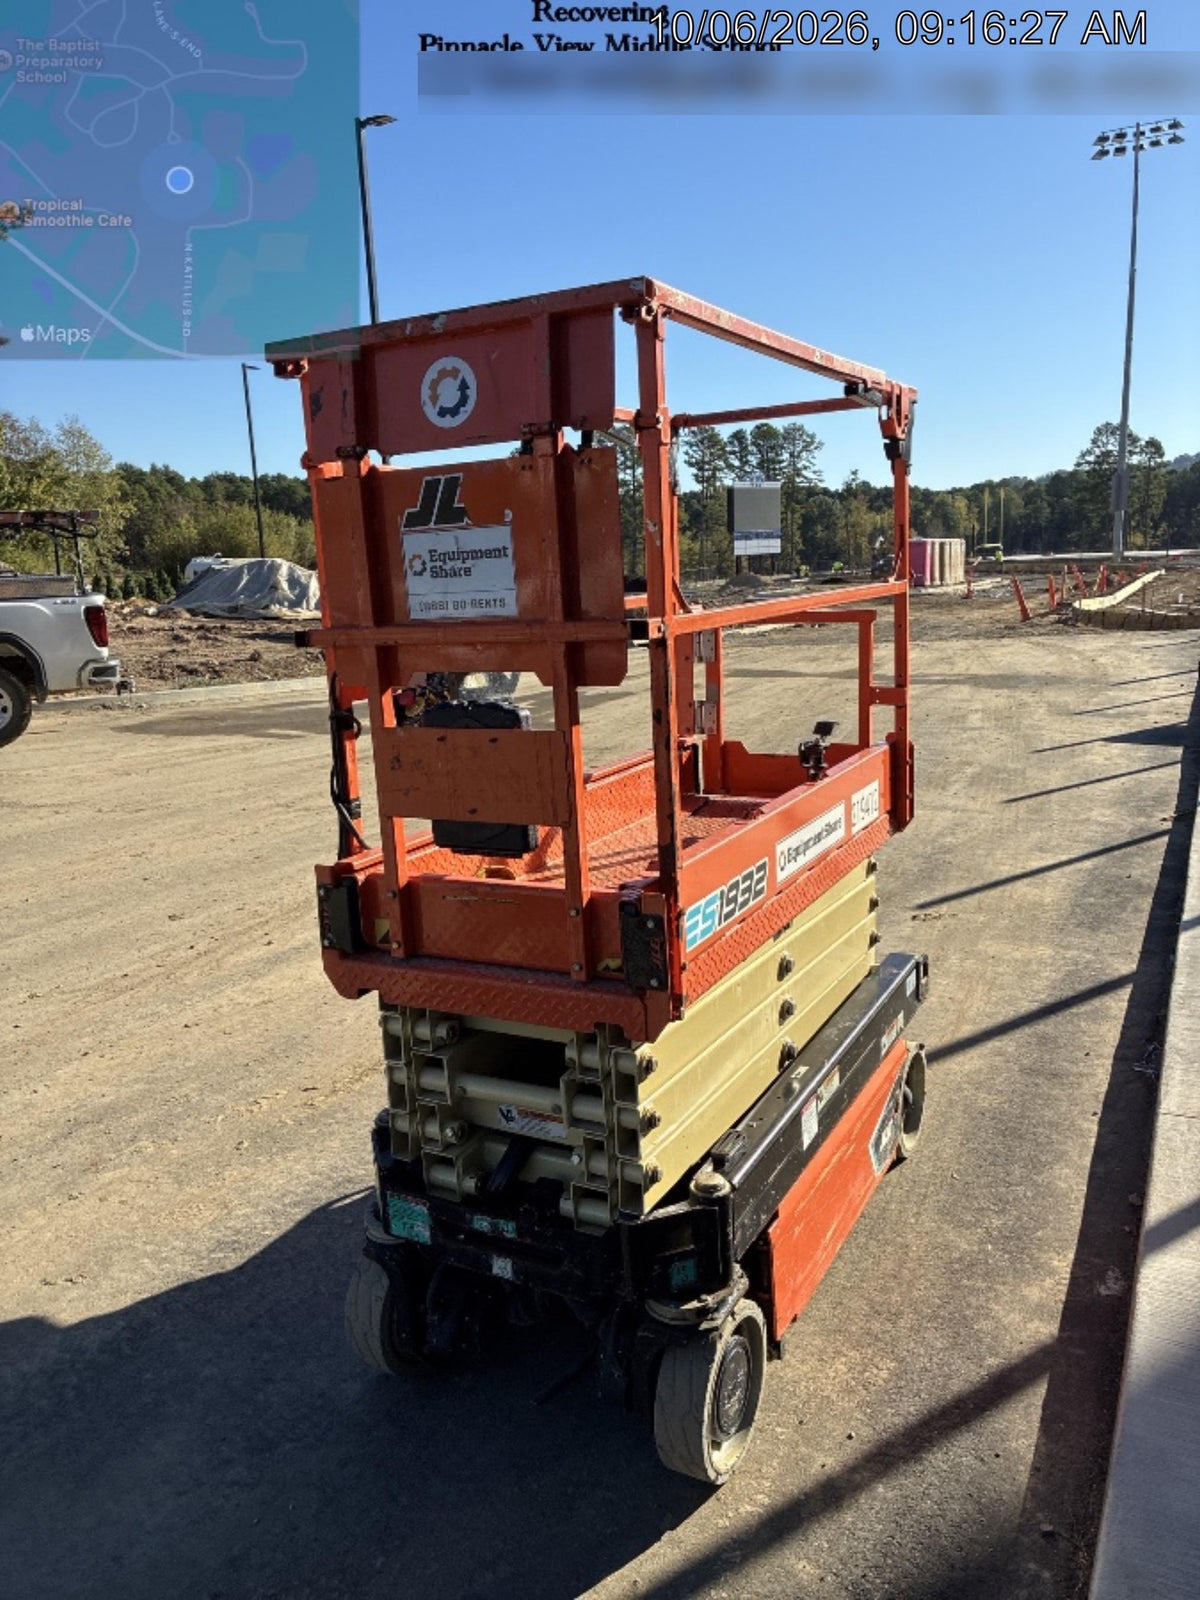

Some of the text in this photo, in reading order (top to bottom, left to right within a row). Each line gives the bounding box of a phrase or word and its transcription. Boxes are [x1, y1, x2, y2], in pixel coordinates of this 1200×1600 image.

[428, 545, 509, 564] Equipment
[430, 564, 473, 580] Share
[685, 857, 768, 953] ES1932
